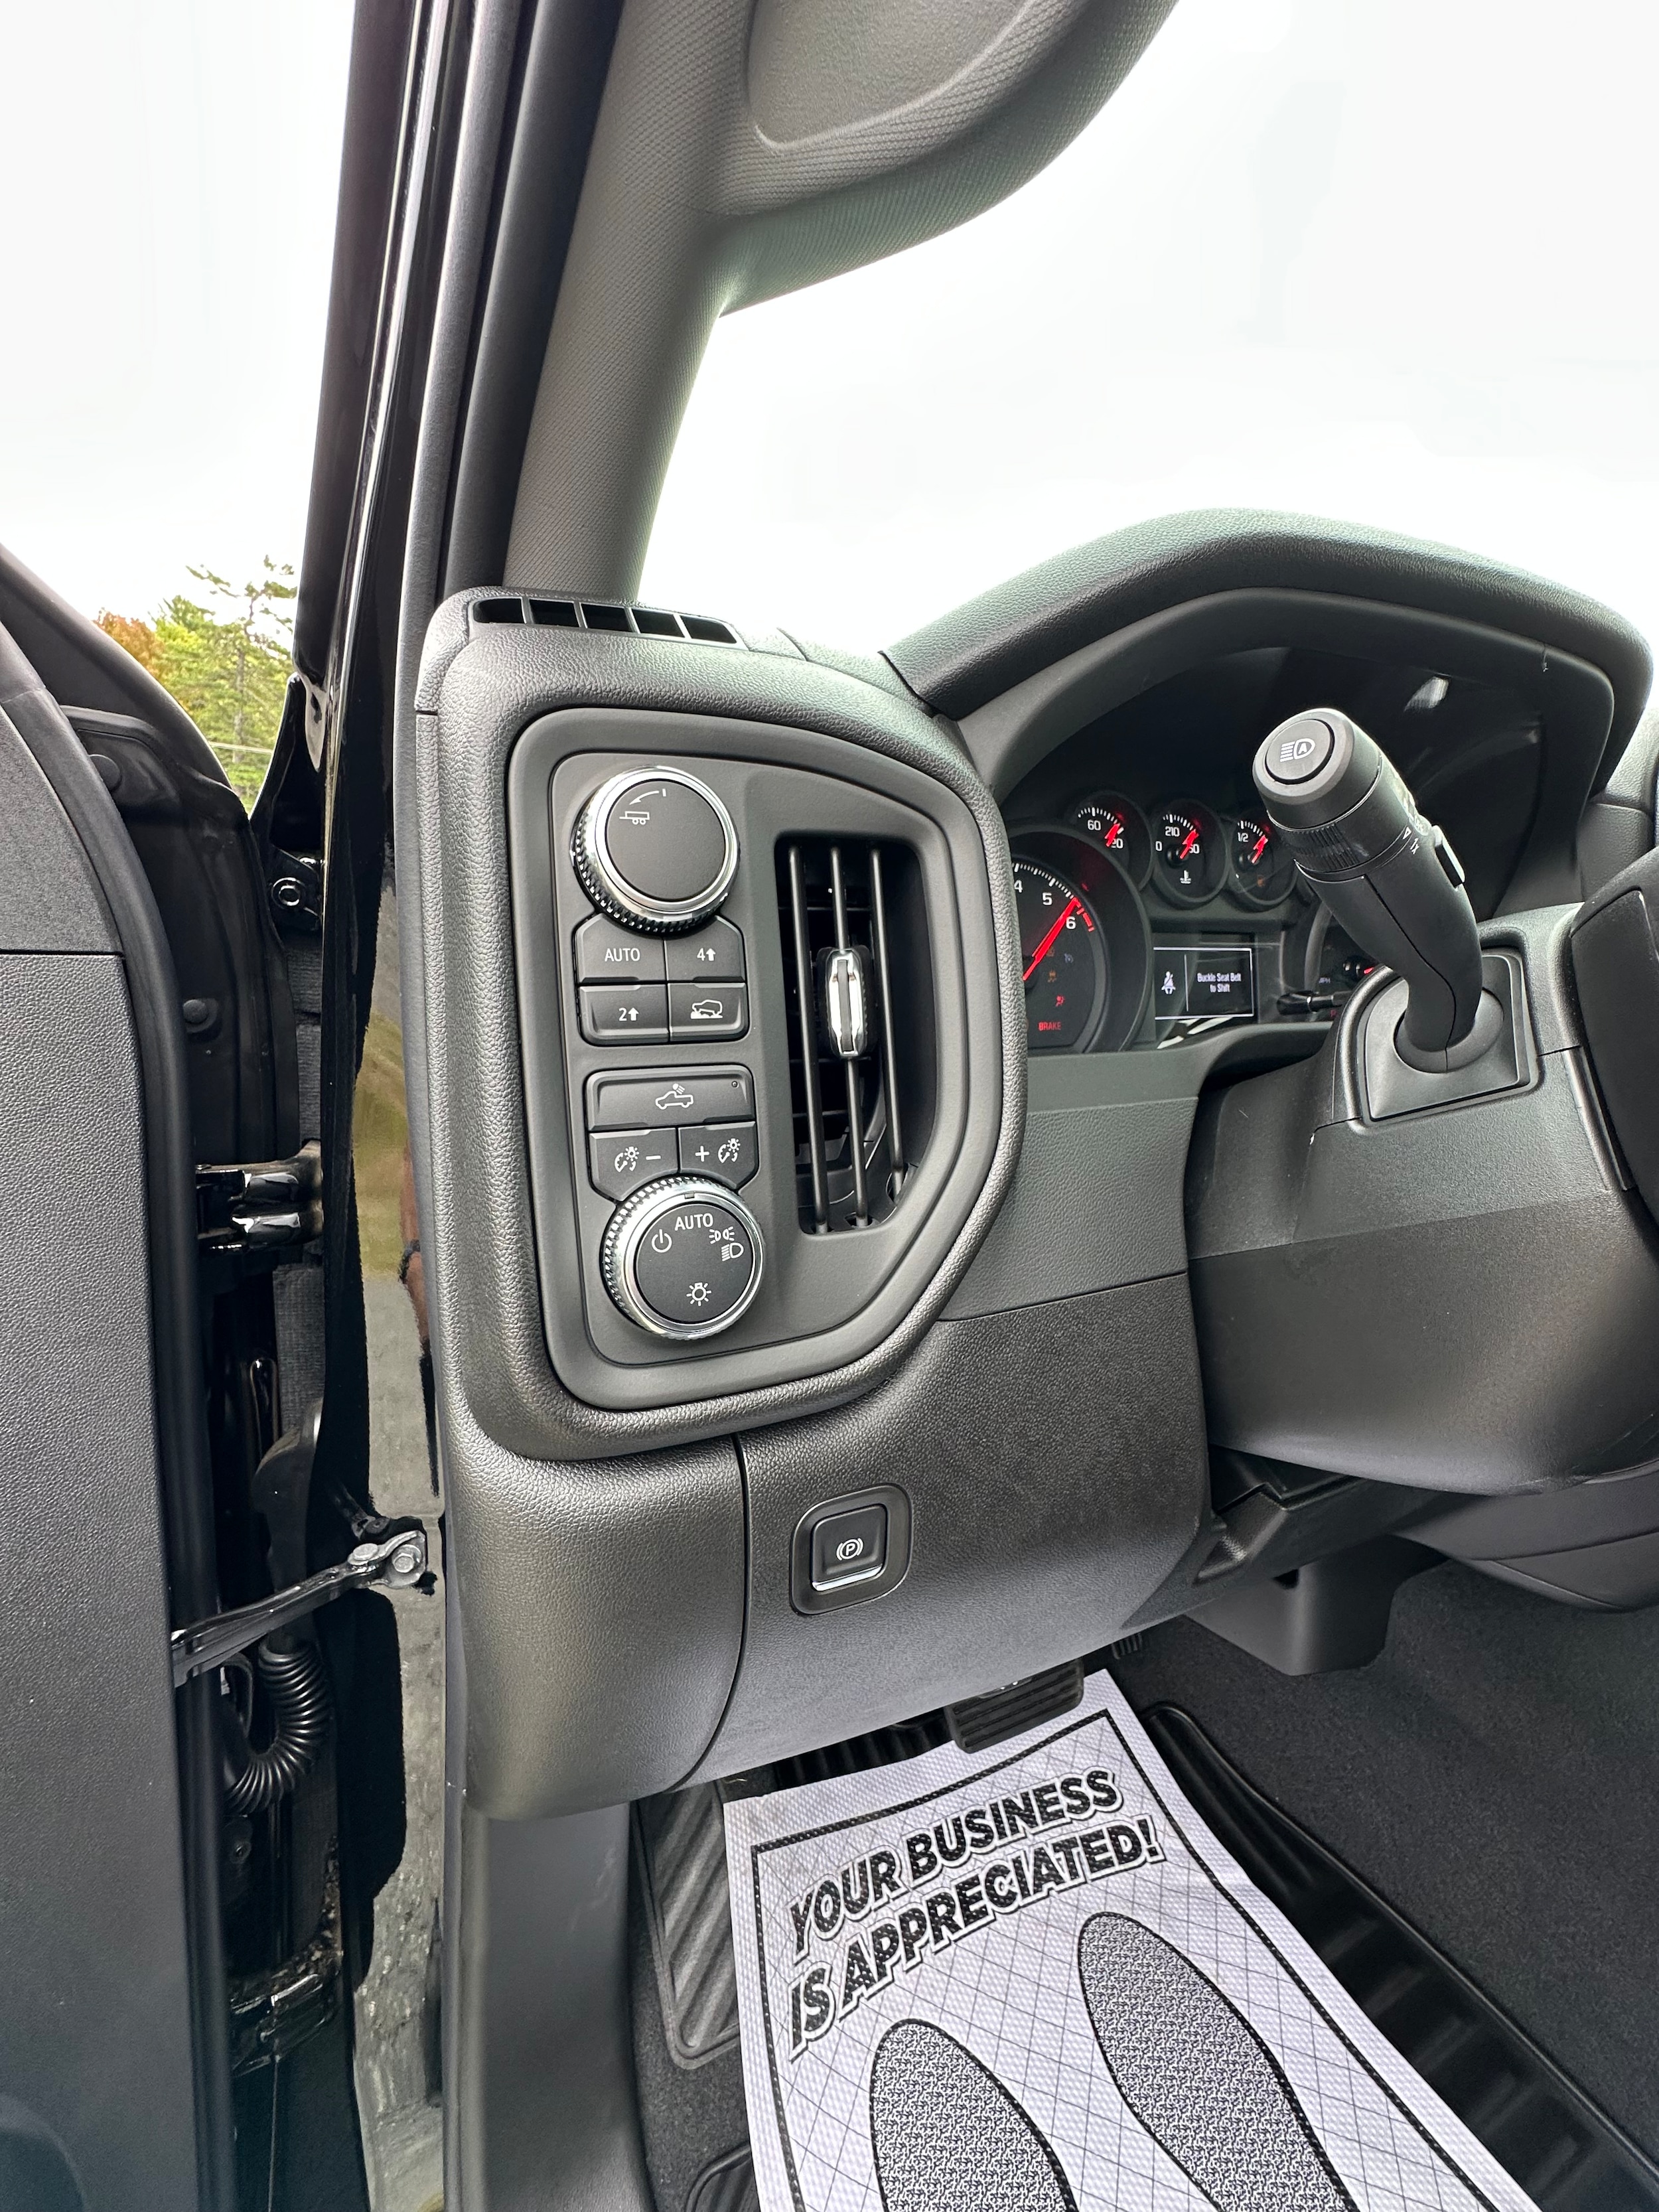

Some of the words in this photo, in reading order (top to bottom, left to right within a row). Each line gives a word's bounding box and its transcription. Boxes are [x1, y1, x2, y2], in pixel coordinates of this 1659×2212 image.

[1087, 820, 1102, 831] 60
[1165, 826, 1180, 838] 210
[1237, 832, 1249, 843] 1/2
[1409, 838, 1419, 855] 1x
[1014, 879, 1023, 893] 4
[1042, 892, 1052, 906] 5
[1066, 916, 1076, 930] 6
[605, 947, 640, 962] AUTO
[696, 948, 706, 962] 4
[1196, 972, 1216, 982] Buckle
[1216, 972, 1230, 982] Seat
[1230, 972, 1242, 982] Belt
[1210, 984, 1216, 993] to
[1217, 983, 1230, 993] Shift
[618, 1007, 628, 1021] 2
[1038, 1021, 1061, 1031] BRAKE
[674, 1213, 713, 1231] AUTO
[846, 1543, 856, 1556] P
[789, 1848, 901, 1961] YOUR
[905, 1767, 1123, 1887] BUSINESS
[790, 1962, 835, 2061] IS
[840, 1814, 1167, 2020] APPRECIATED!
